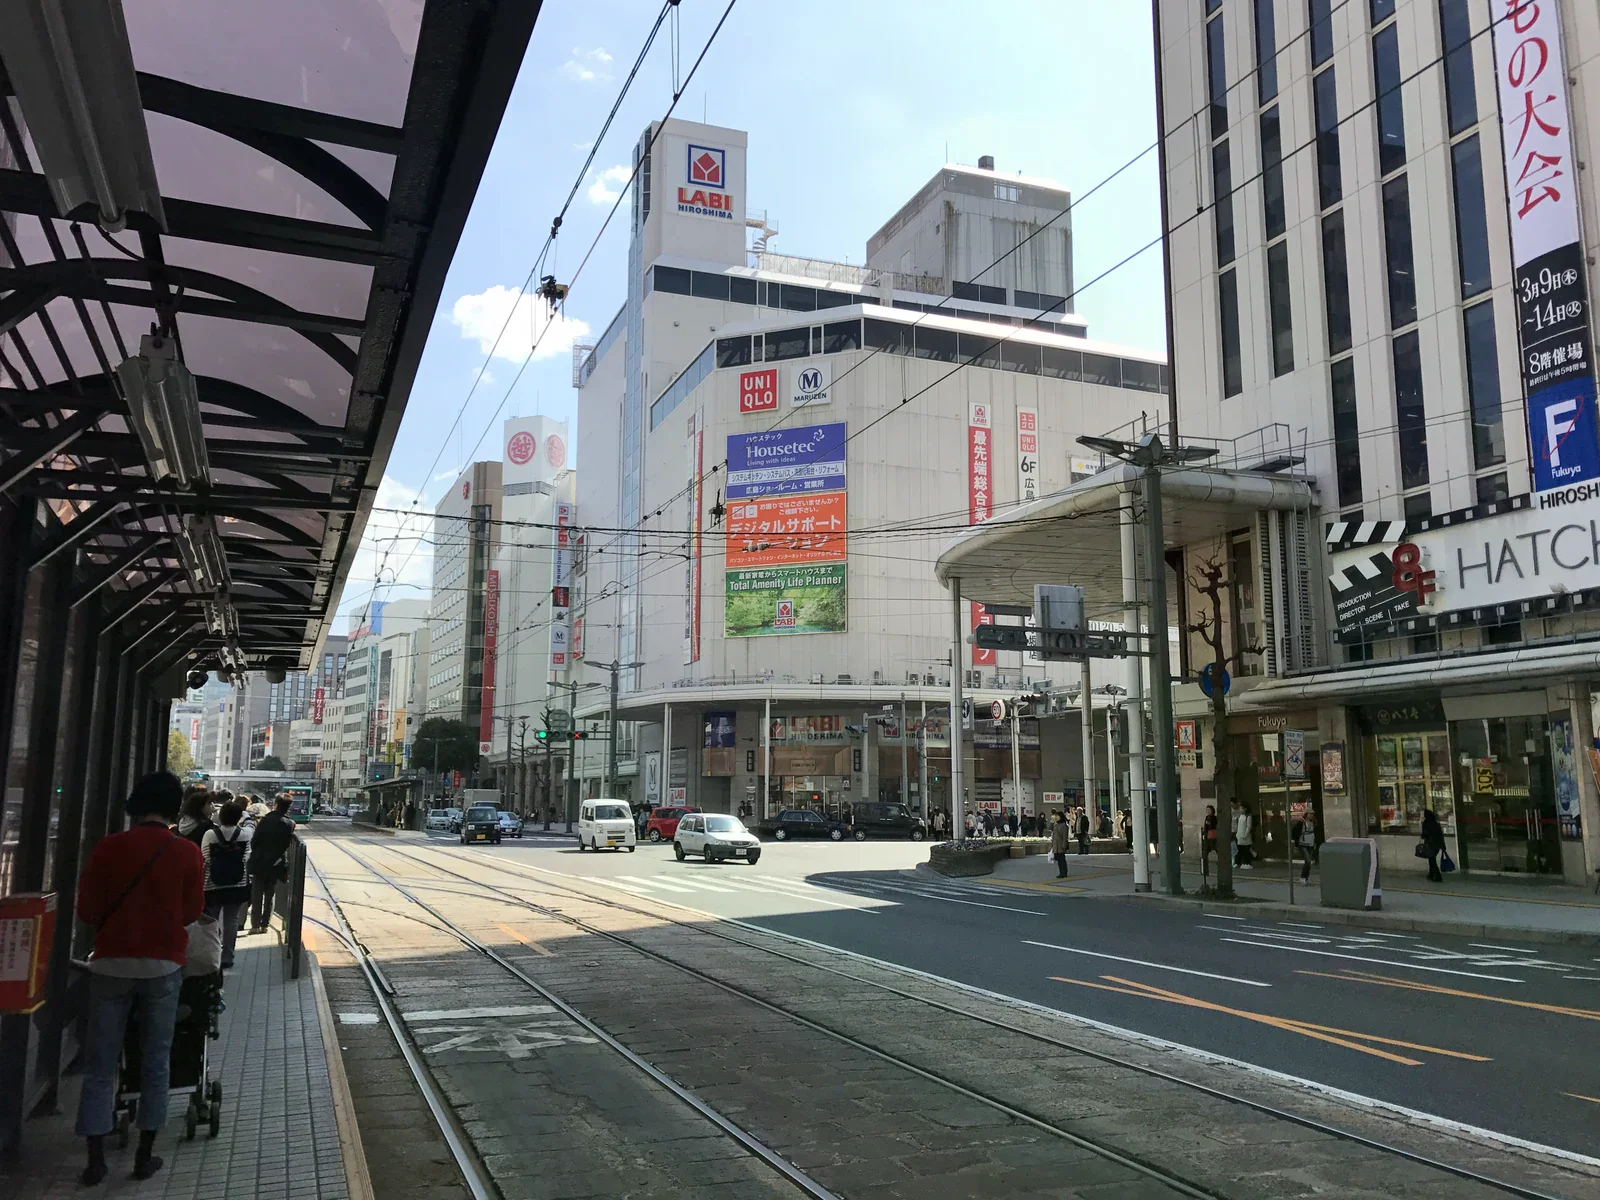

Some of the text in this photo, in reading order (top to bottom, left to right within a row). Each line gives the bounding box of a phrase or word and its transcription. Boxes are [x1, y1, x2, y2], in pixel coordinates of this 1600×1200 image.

[678, 187, 733, 211] LABI
[678, 204, 733, 219] HIROSHIMA
[1529, 342, 1583, 374] 8階催場
[744, 373, 771, 390] UNI
[744, 390, 773, 408] QLO
[794, 393, 827, 402] MARUZEN
[746, 442, 815, 458] Housetec
[747, 459, 764, 467] Living
[1021, 456, 1037, 474] 6F
[974, 431, 989, 524] 最先端総合家
[1551, 465, 1582, 480] Fukuya
[1540, 482, 1600, 510] HIROSH
[730, 515, 841, 539] デジタルサポート
[730, 575, 842, 591] Total Amenity Life Planner
[1337, 591, 1373, 611] PRODUCTION
[1394, 599, 1411, 613] TAKE
[1339, 604, 1367, 622] DIRECTOR
[1365, 611, 1385, 625] SCENE
[774, 618, 796, 626] LABI
[1258, 716, 1288, 732] Fukuya
[791, 733, 844, 742] HIROSHIMA
